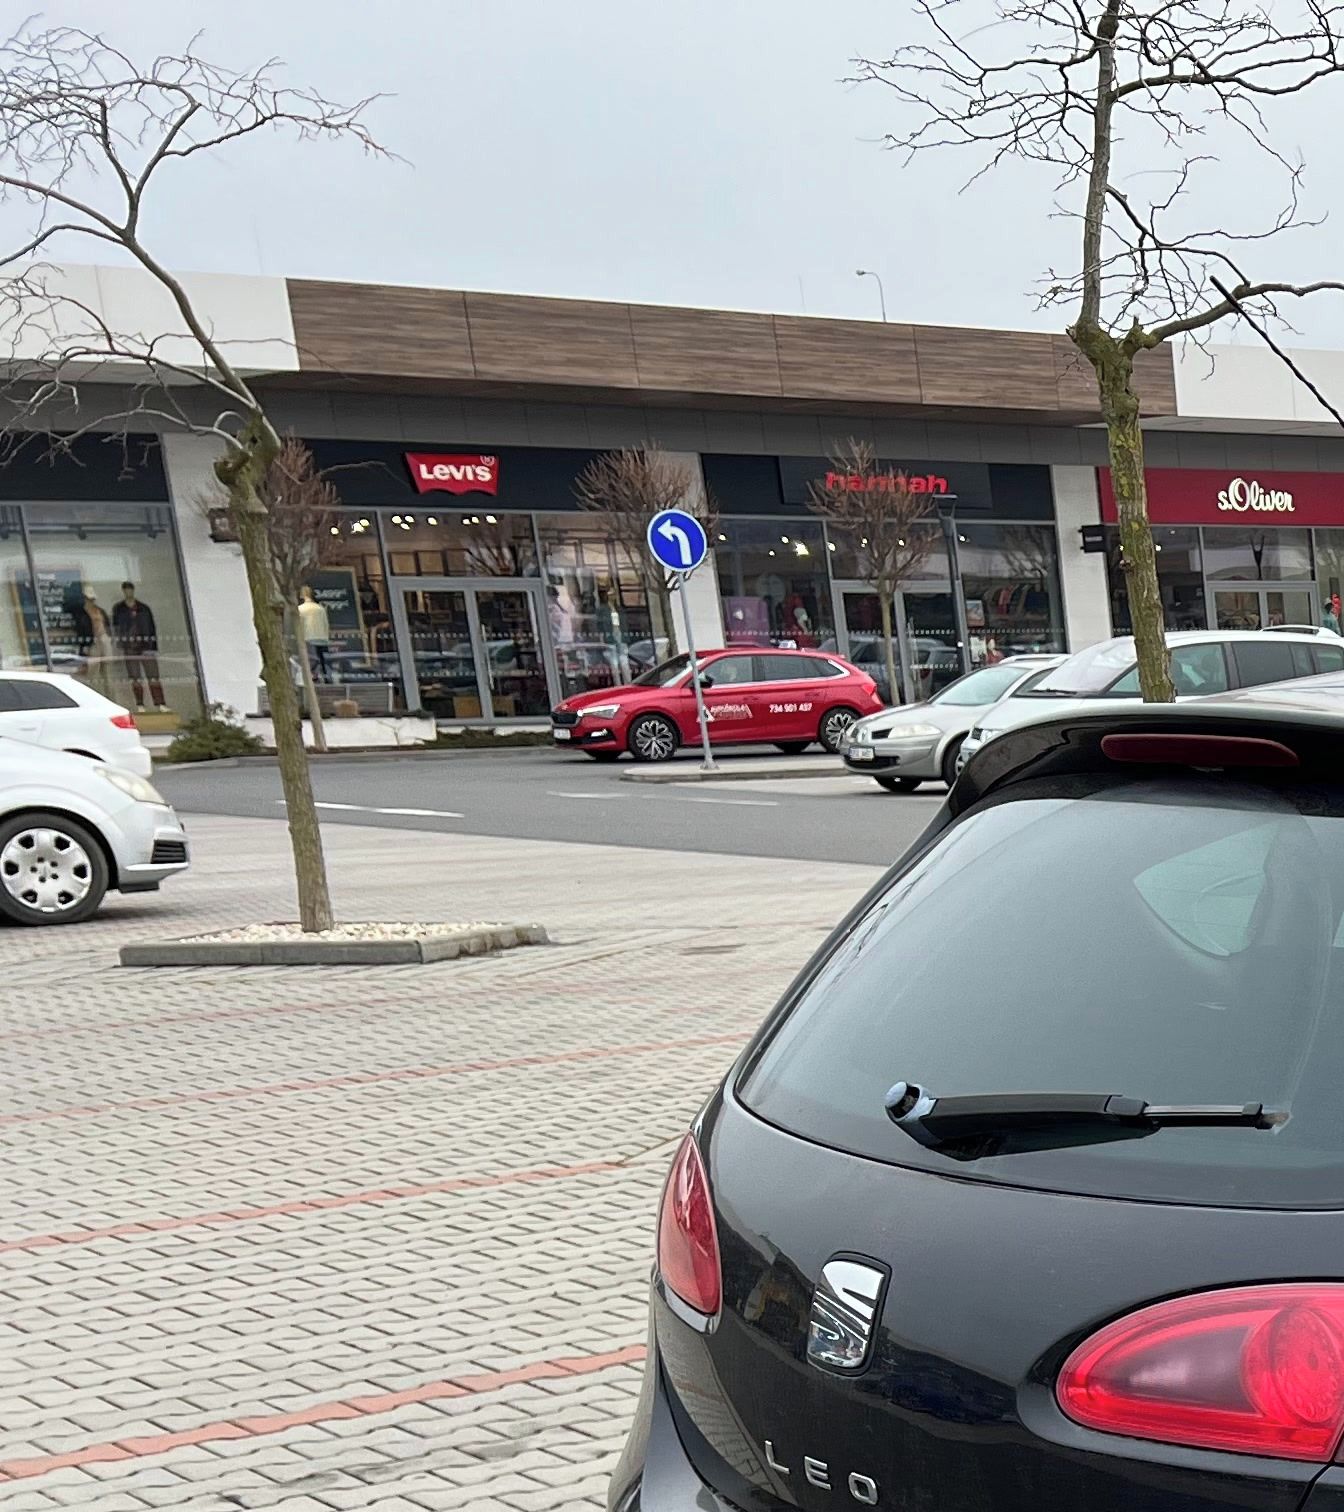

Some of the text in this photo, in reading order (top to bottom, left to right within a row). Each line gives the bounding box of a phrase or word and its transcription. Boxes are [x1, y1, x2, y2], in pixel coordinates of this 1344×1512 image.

[825, 471, 948, 493] hannah
[1217, 477, 1296, 512] s.Oliver
[764, 1439, 879, 1506] LEO
